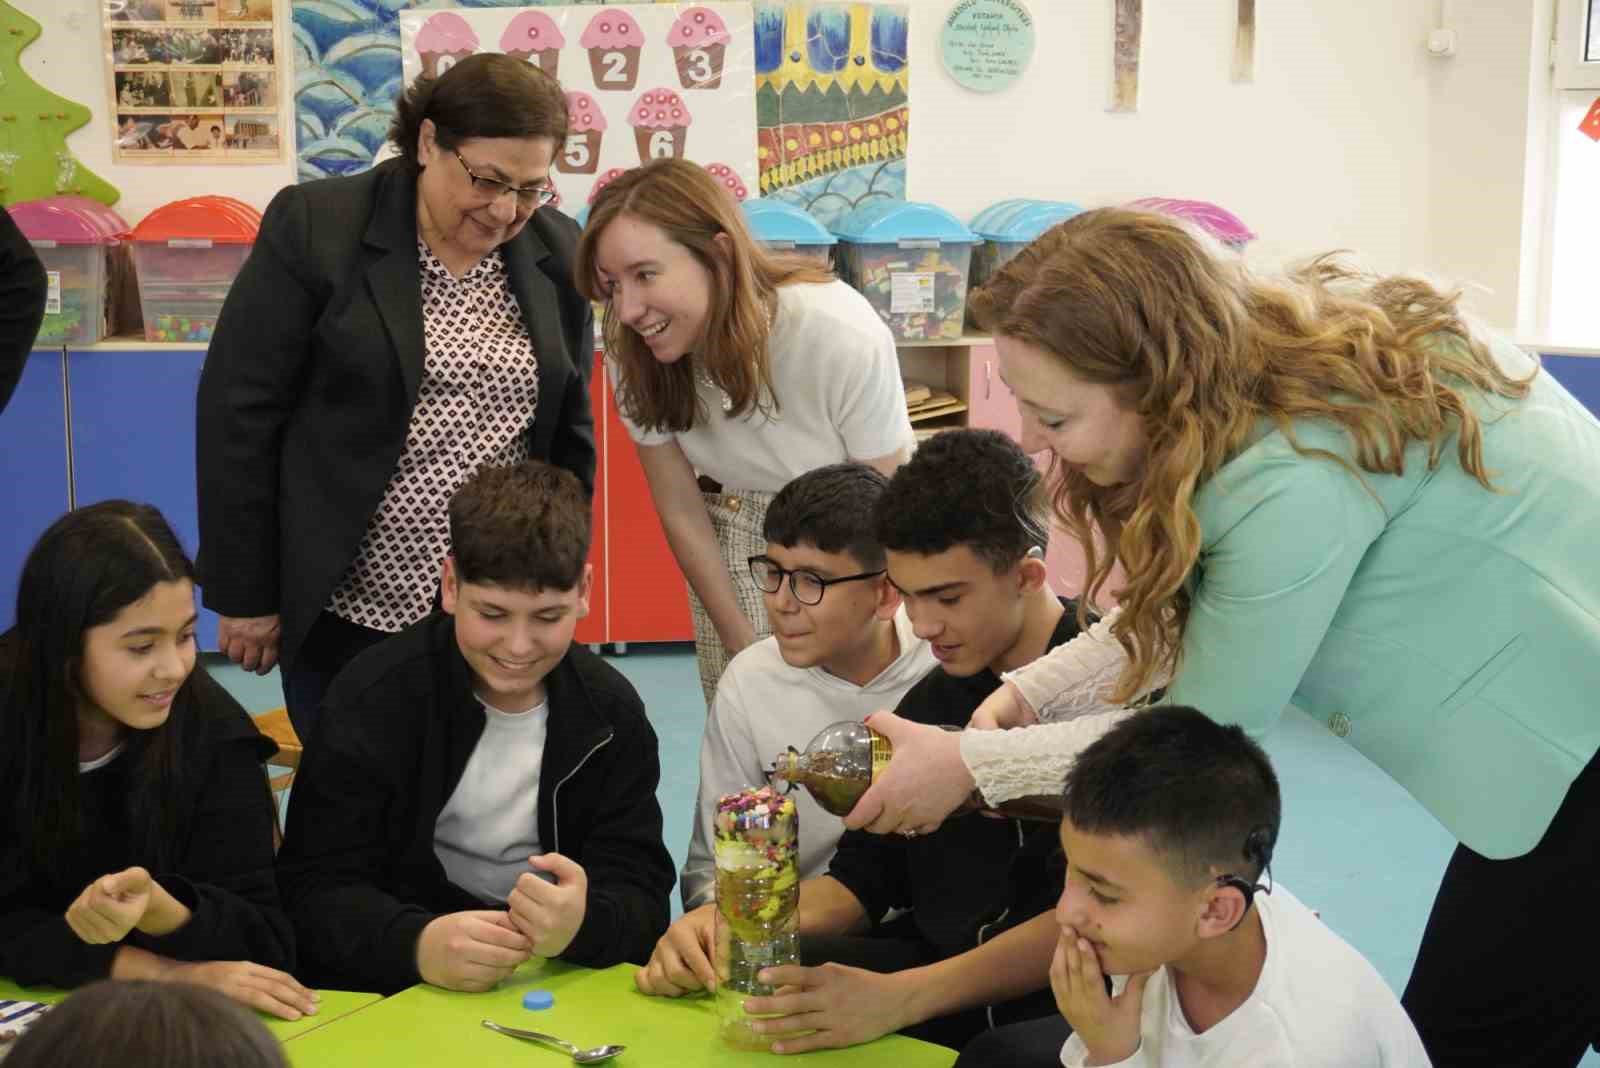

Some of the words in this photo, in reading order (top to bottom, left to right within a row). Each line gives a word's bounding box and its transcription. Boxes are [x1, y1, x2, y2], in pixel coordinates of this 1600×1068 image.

[602, 52, 627, 81] 2
[688, 50, 712, 81] 3
[565, 134, 590, 167] 5
[649, 130, 675, 159] 6
